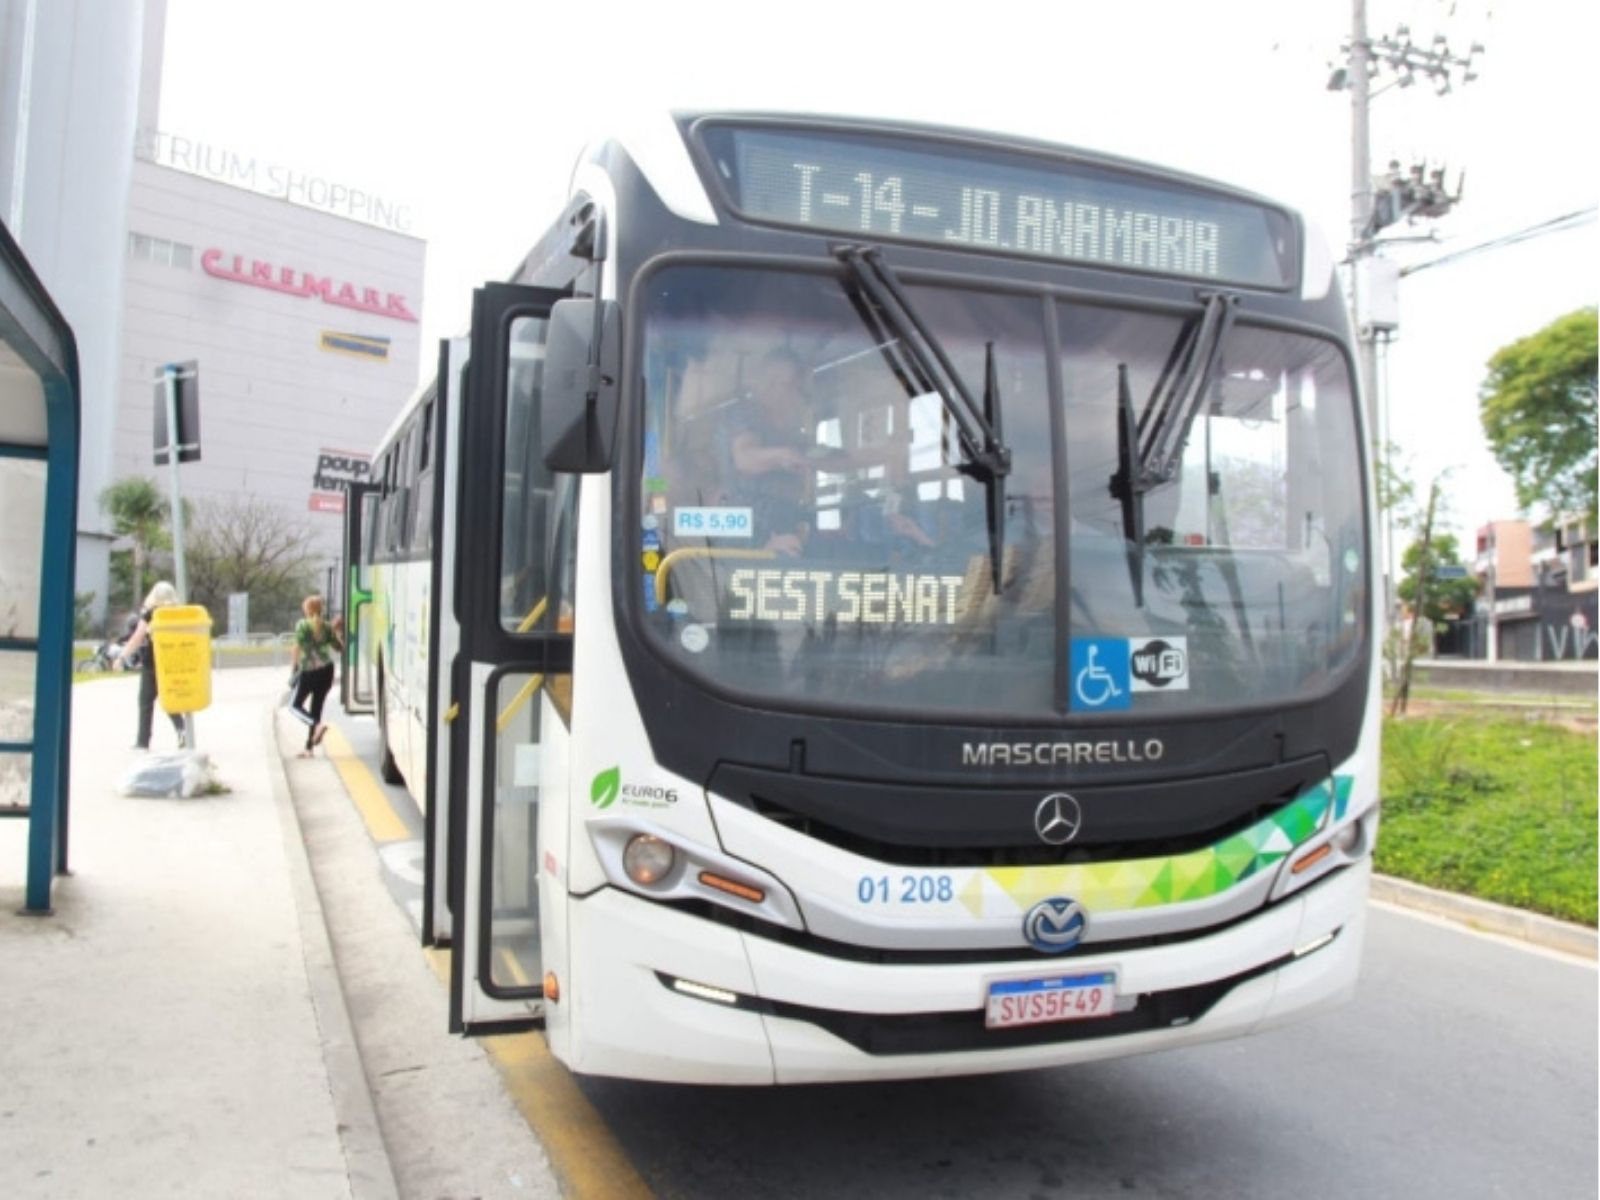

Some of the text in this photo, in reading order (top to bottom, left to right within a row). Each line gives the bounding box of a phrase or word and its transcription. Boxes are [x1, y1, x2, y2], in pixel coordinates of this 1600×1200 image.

[138, 130, 413, 231] TRIUM SHOPPING
[201, 248, 419, 324] CINEMARK
[679, 513, 704, 529] R$
[962, 738, 1164, 765] MASCARELLO
[858, 876, 954, 903] 01 208
[1001, 988, 1103, 1022] SVS5F49
